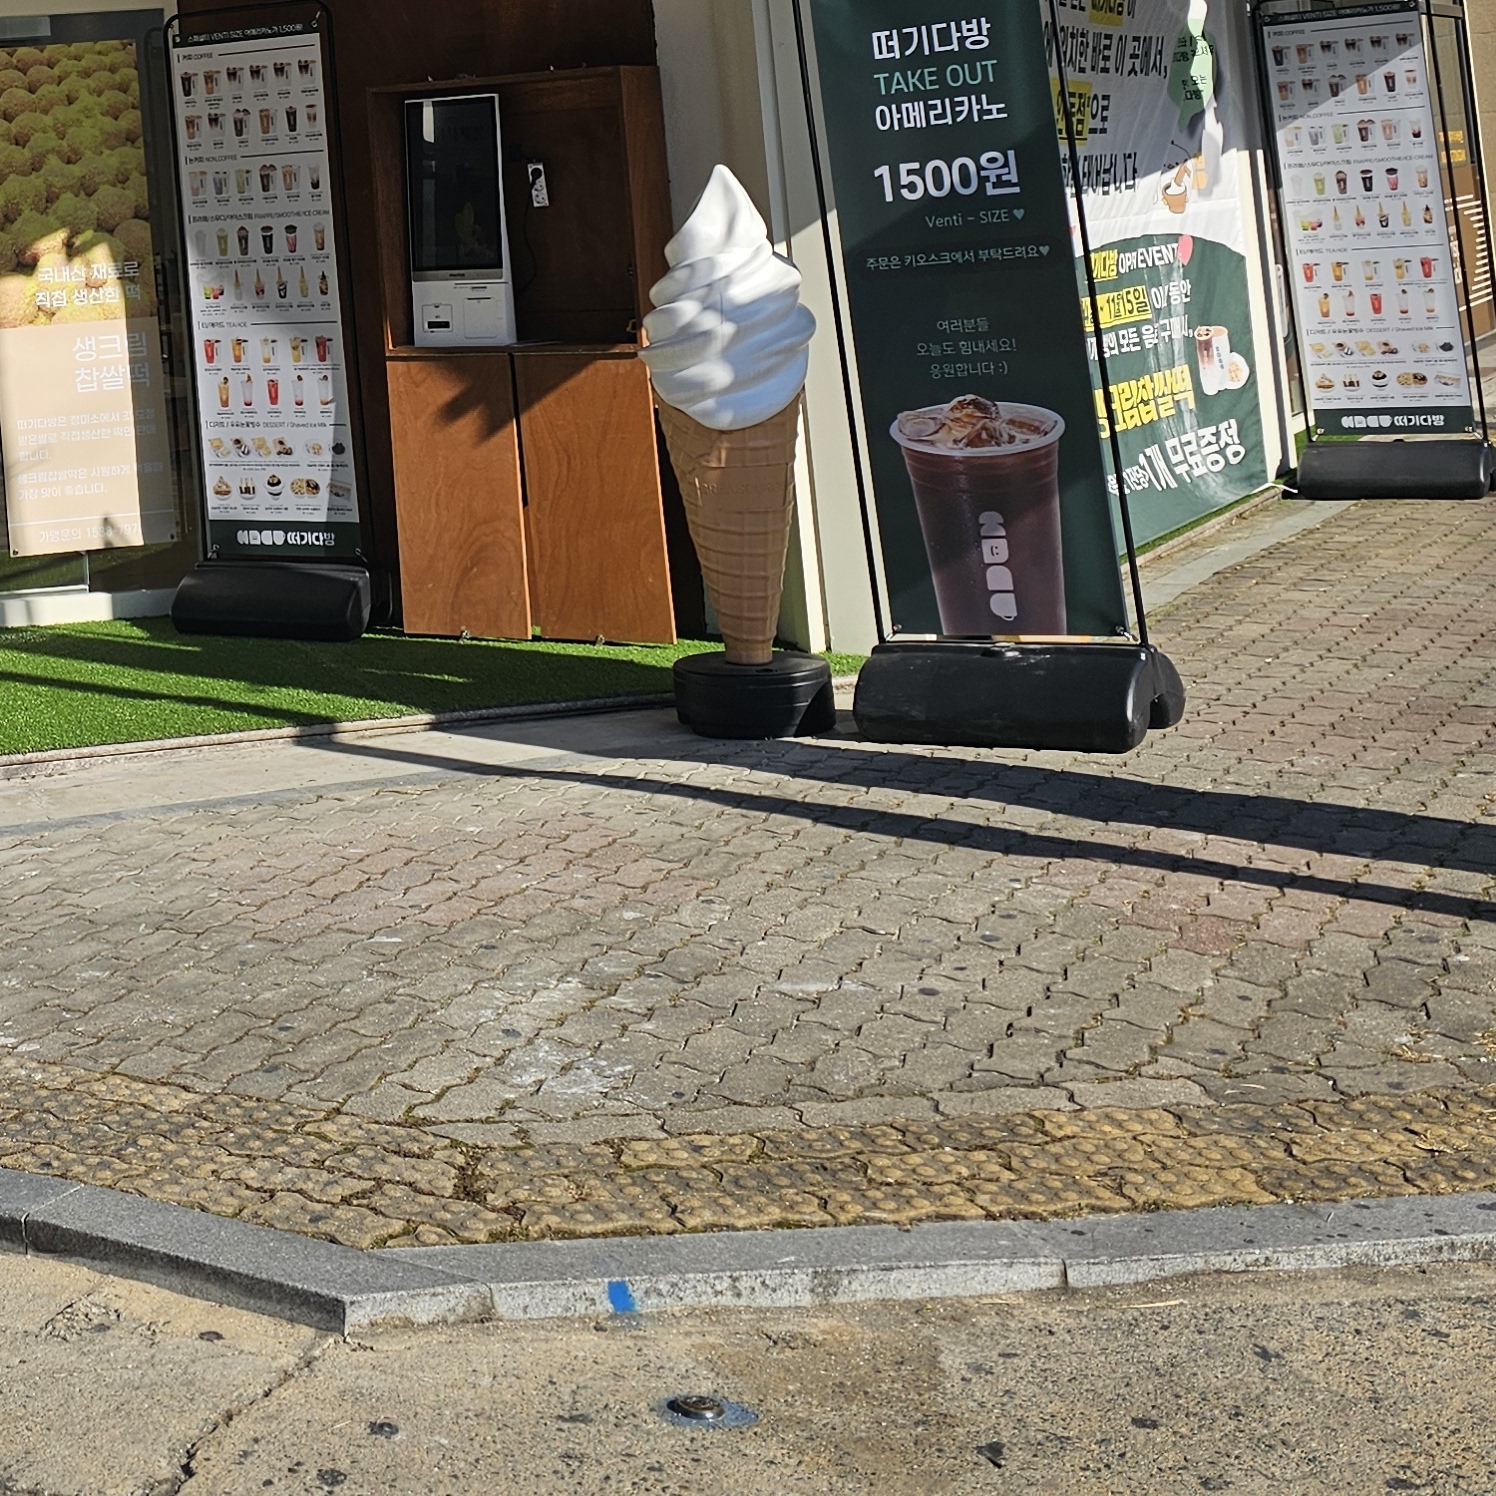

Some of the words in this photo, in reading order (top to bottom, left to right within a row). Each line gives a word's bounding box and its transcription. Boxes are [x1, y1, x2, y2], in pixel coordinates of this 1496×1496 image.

[871, 17, 991, 60] 떠기다방
[1090, 31, 1114, 75] 바로
[873, 67, 940, 95] TAKE
[945, 59, 998, 87] OUT
[875, 94, 1008, 131] 아메리카노
[873, 149, 1021, 203] 1500원
[925, 213, 963, 229] Venti
[979, 209, 1010, 224] SIZE
[866, 256, 902, 271] 주문은
[904, 249, 975, 268] 키오스크에서
[37, 265, 87, 284] 국내산
[91, 261, 141, 281] 재료로
[34, 290, 68, 308] 직접
[72, 287, 122, 305] 생산한
[936, 316, 990, 334] 여러분들
[72, 331, 148, 363] 생크림
[916, 342, 956, 357] 오늘도
[959, 338, 1017, 355] 힘내세요!
[74, 362, 151, 394] 찹쌀떡
[929, 361, 995, 380] 응원합니다
[1393, 414, 1445, 427] 떠기다방
[1164, 418, 1246, 484] 무료증정
[286, 531, 335, 547] 떠기다방
